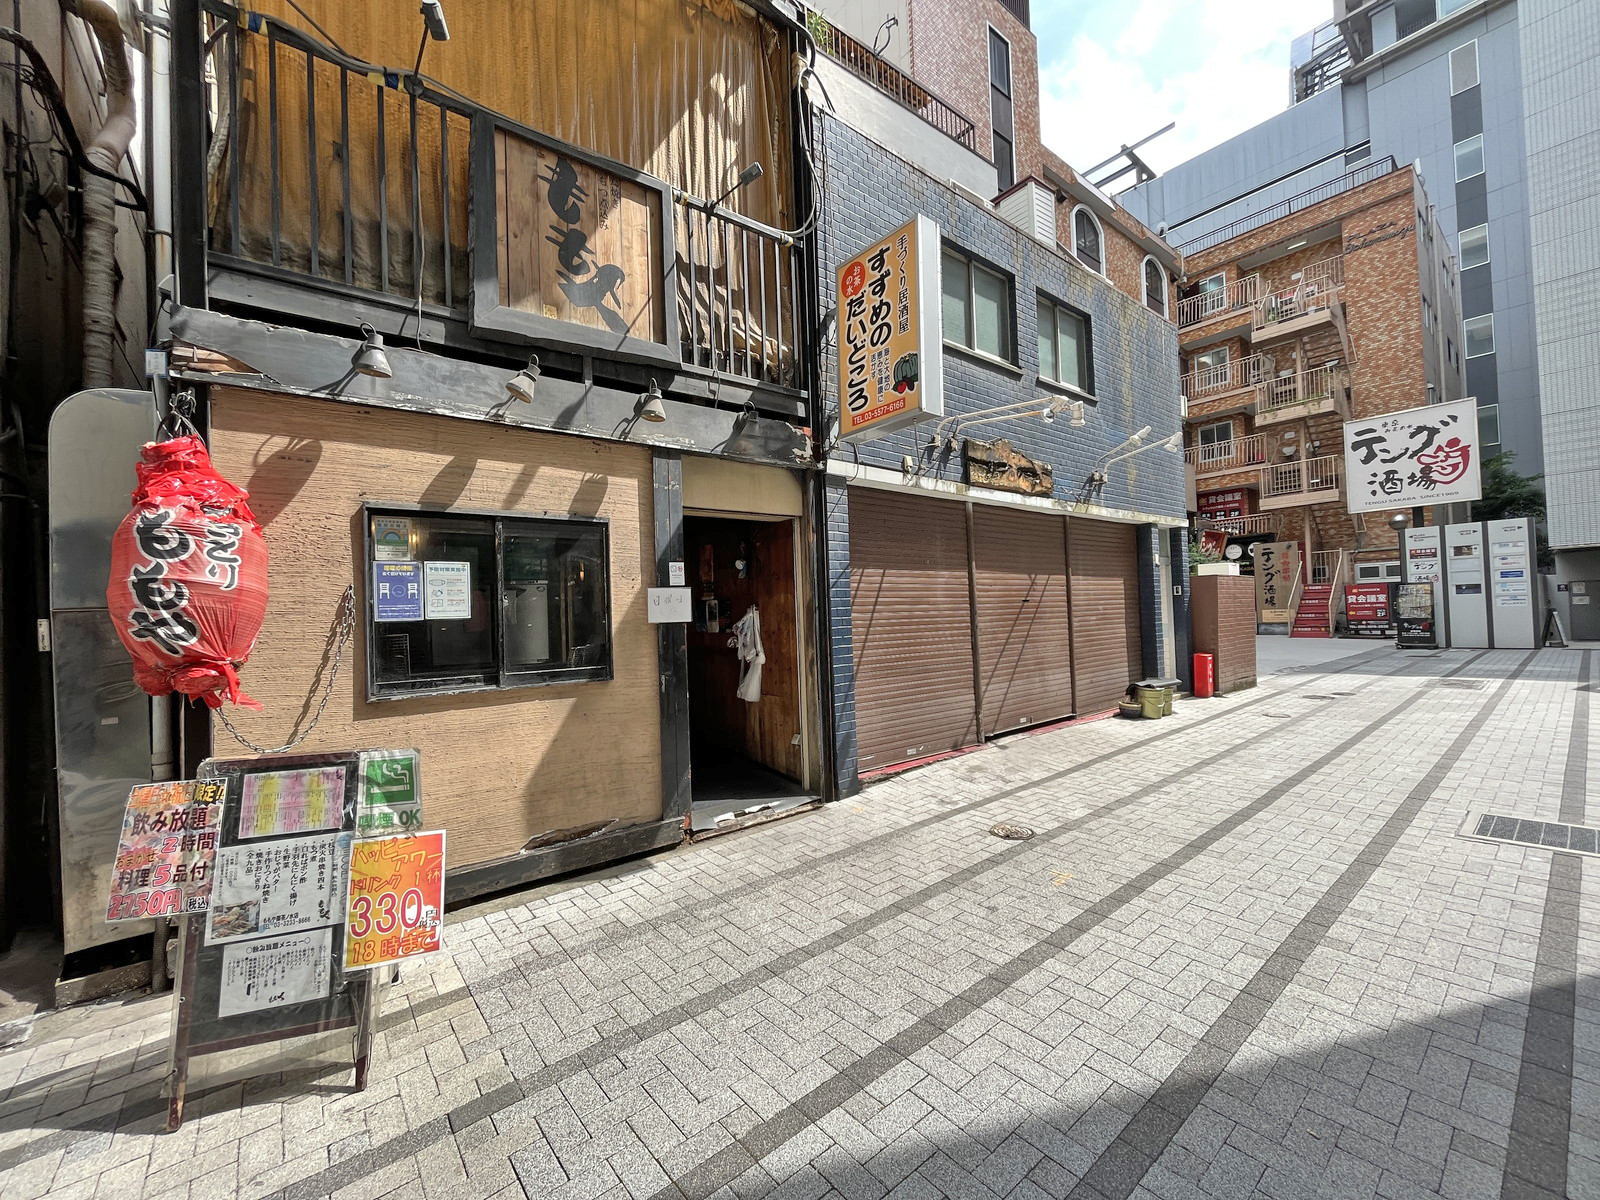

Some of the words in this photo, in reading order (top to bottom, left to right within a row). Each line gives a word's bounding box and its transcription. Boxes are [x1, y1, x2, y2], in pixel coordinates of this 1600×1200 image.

[867, 245, 893, 348] すずめの
[896, 234, 909, 335] 手づくり居酒屋
[846, 289, 869, 413] だいどころ
[1351, 414, 1458, 465] テング
[1367, 465, 1437, 497] 酒場
[1347, 594, 1387, 603] 貸会議室
[131, 807, 208, 836] 飲み放題
[400, 809, 421, 826] OK
[161, 832, 216, 853] 2時間
[350, 838, 415, 867] ハッピー
[391, 850, 443, 871] アワー
[350, 874, 402, 896] ドリンク
[107, 888, 183, 919] 2750円
[352, 930, 435, 963] 18時まで
